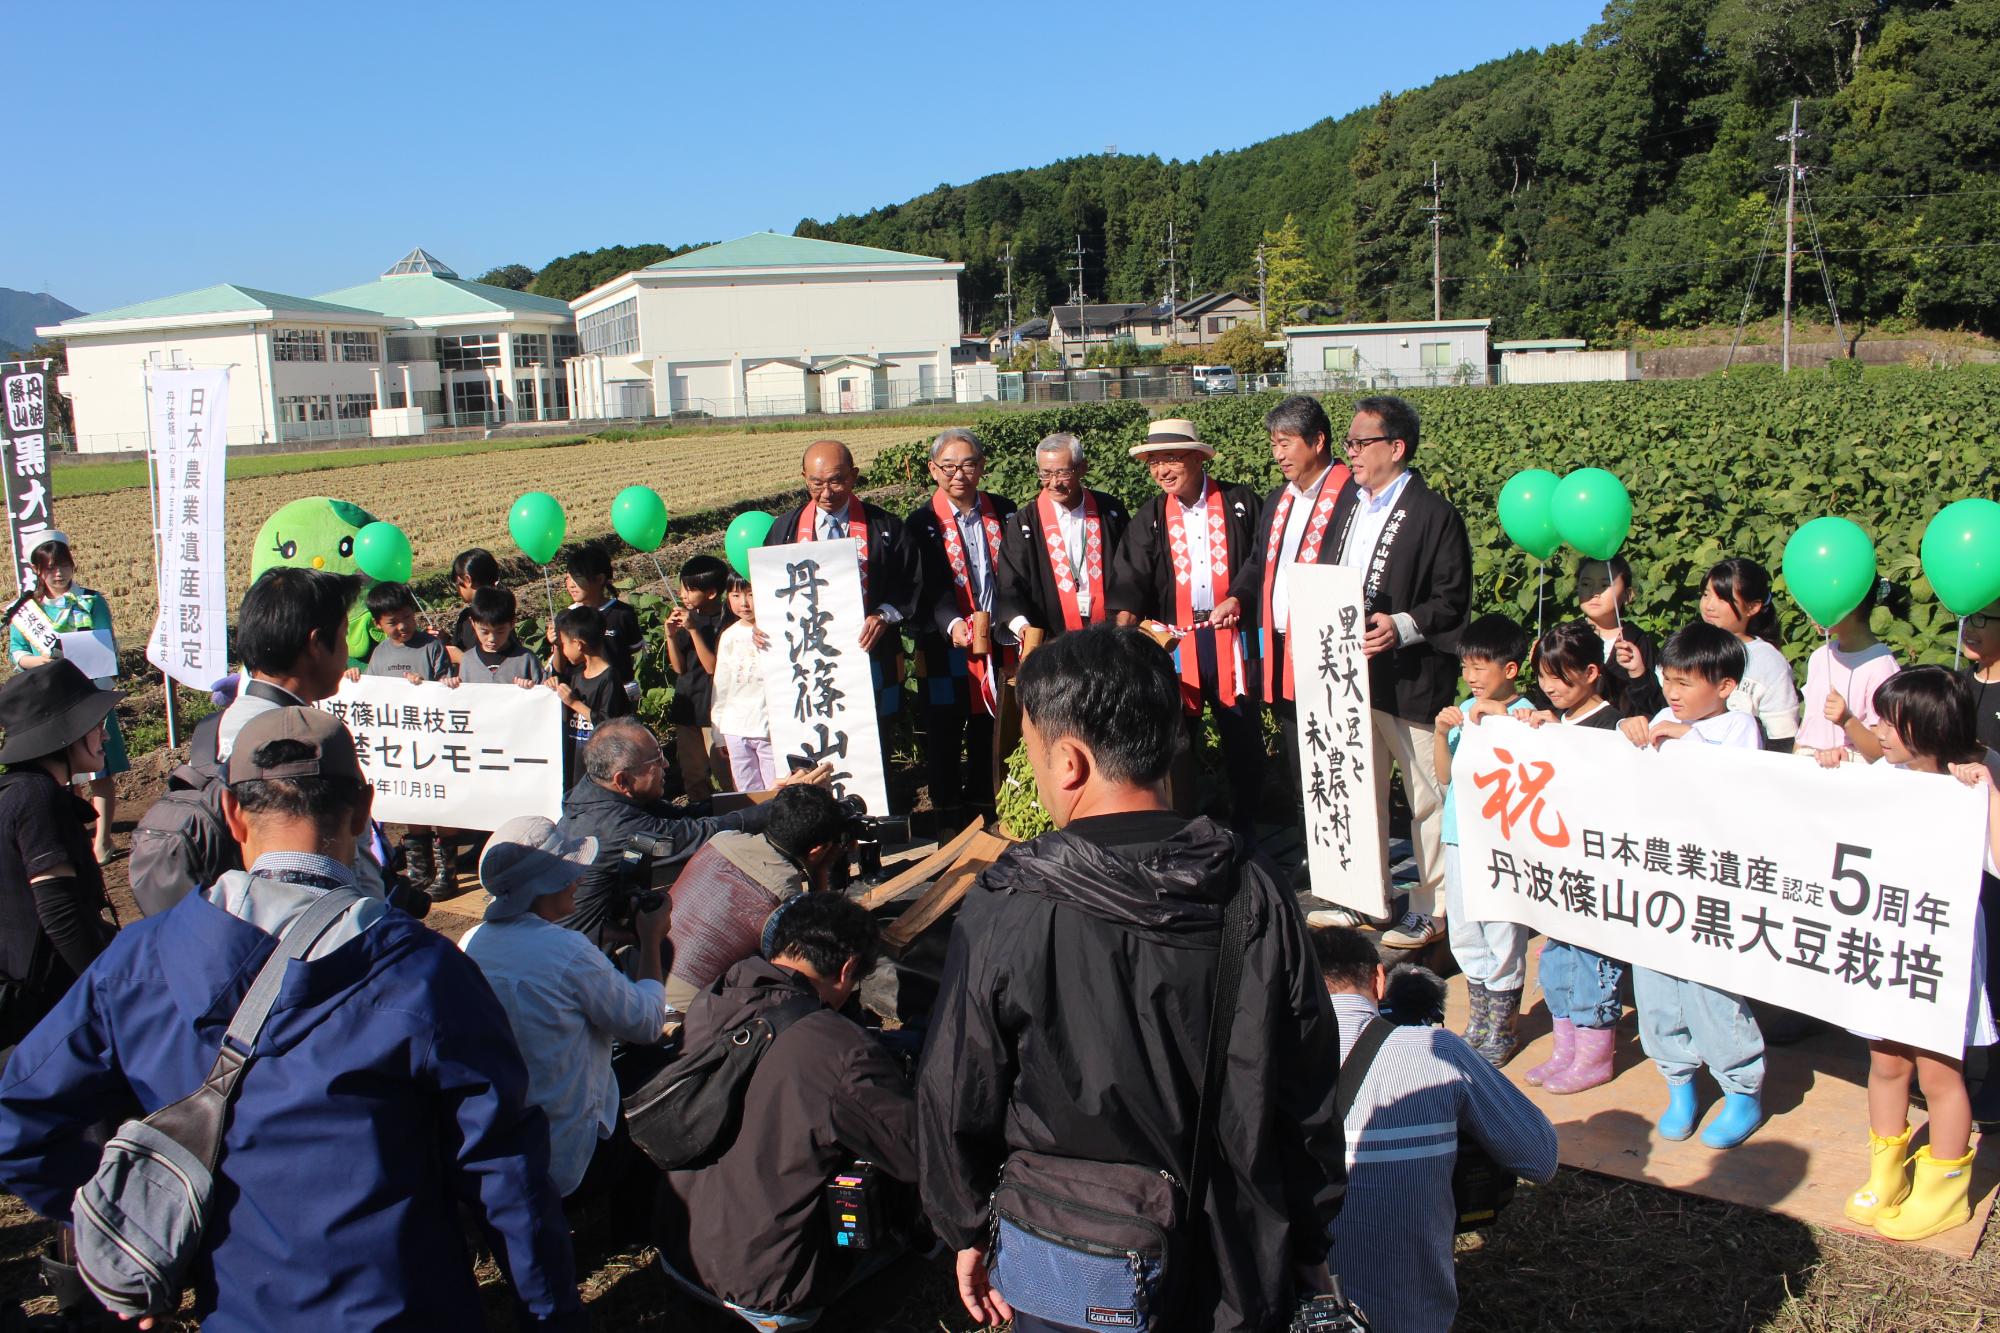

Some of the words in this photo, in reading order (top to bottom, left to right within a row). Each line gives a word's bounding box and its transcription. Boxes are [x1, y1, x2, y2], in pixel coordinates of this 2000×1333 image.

[14, 433, 48, 593] 黒大
[180, 388, 204, 669] 日本農業遺産認定
[311, 700, 474, 735] 波篠山黒枝豆
[1305, 711, 1332, 848] 未来に
[1473, 748, 1571, 849] 祝
[1486, 848, 1944, 1004] 丹波篠山の黒大豆栽培
